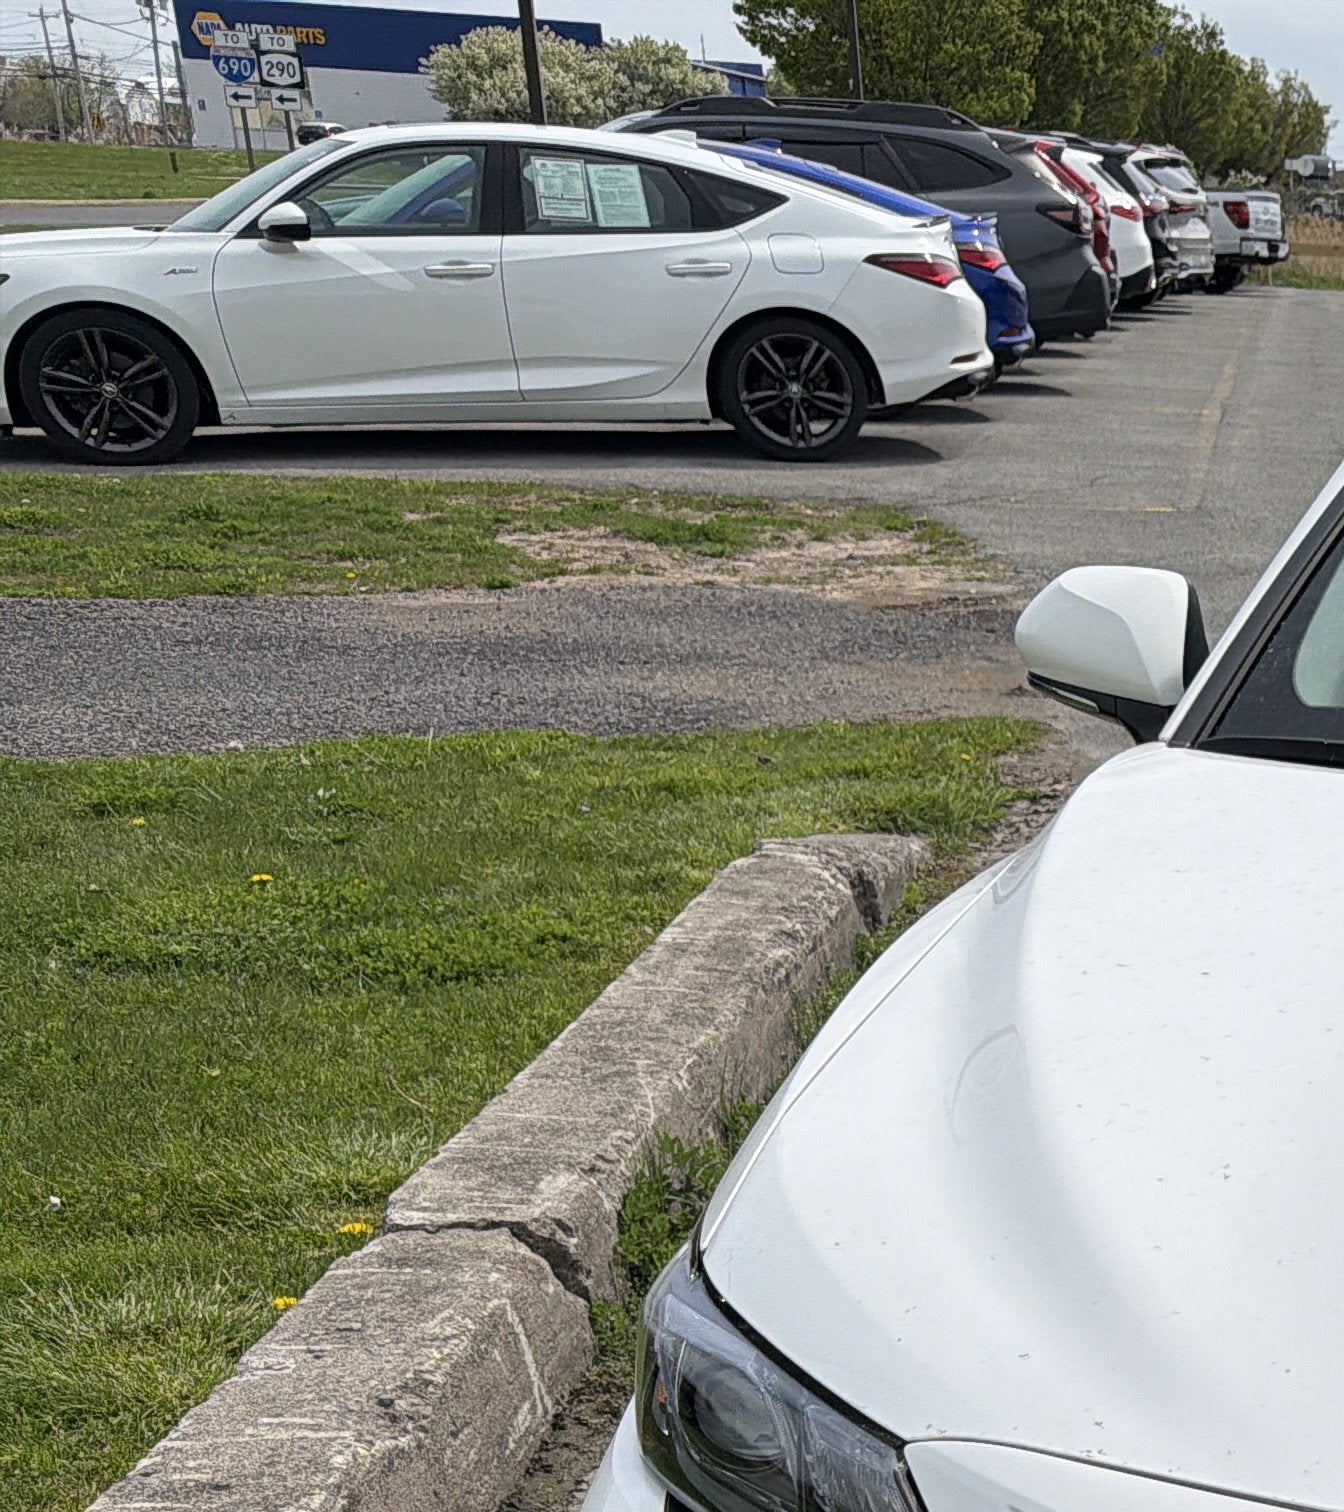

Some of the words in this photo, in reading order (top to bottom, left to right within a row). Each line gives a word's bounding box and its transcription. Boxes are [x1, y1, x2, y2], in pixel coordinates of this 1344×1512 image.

[222, 32, 240, 45] TO
[267, 36, 286, 48] TO
[218, 57, 251, 77] 690
[265, 60, 296, 78] 290
